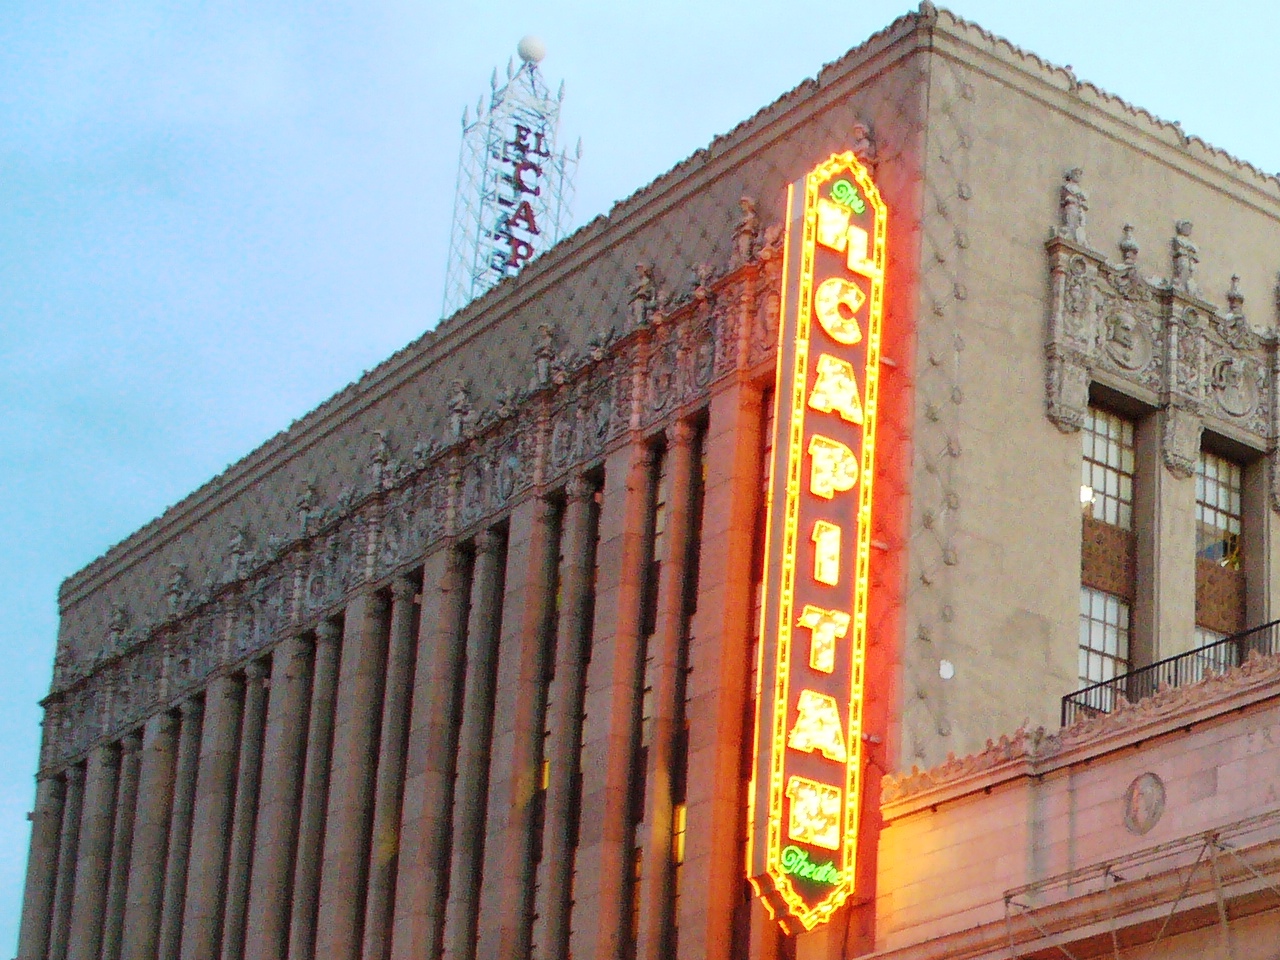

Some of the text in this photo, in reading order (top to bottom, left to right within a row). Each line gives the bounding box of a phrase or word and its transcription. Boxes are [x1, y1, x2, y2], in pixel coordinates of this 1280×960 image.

[514, 123, 551, 158] EL
[816, 198, 877, 278] EL
[785, 277, 867, 850] CAPITAN
